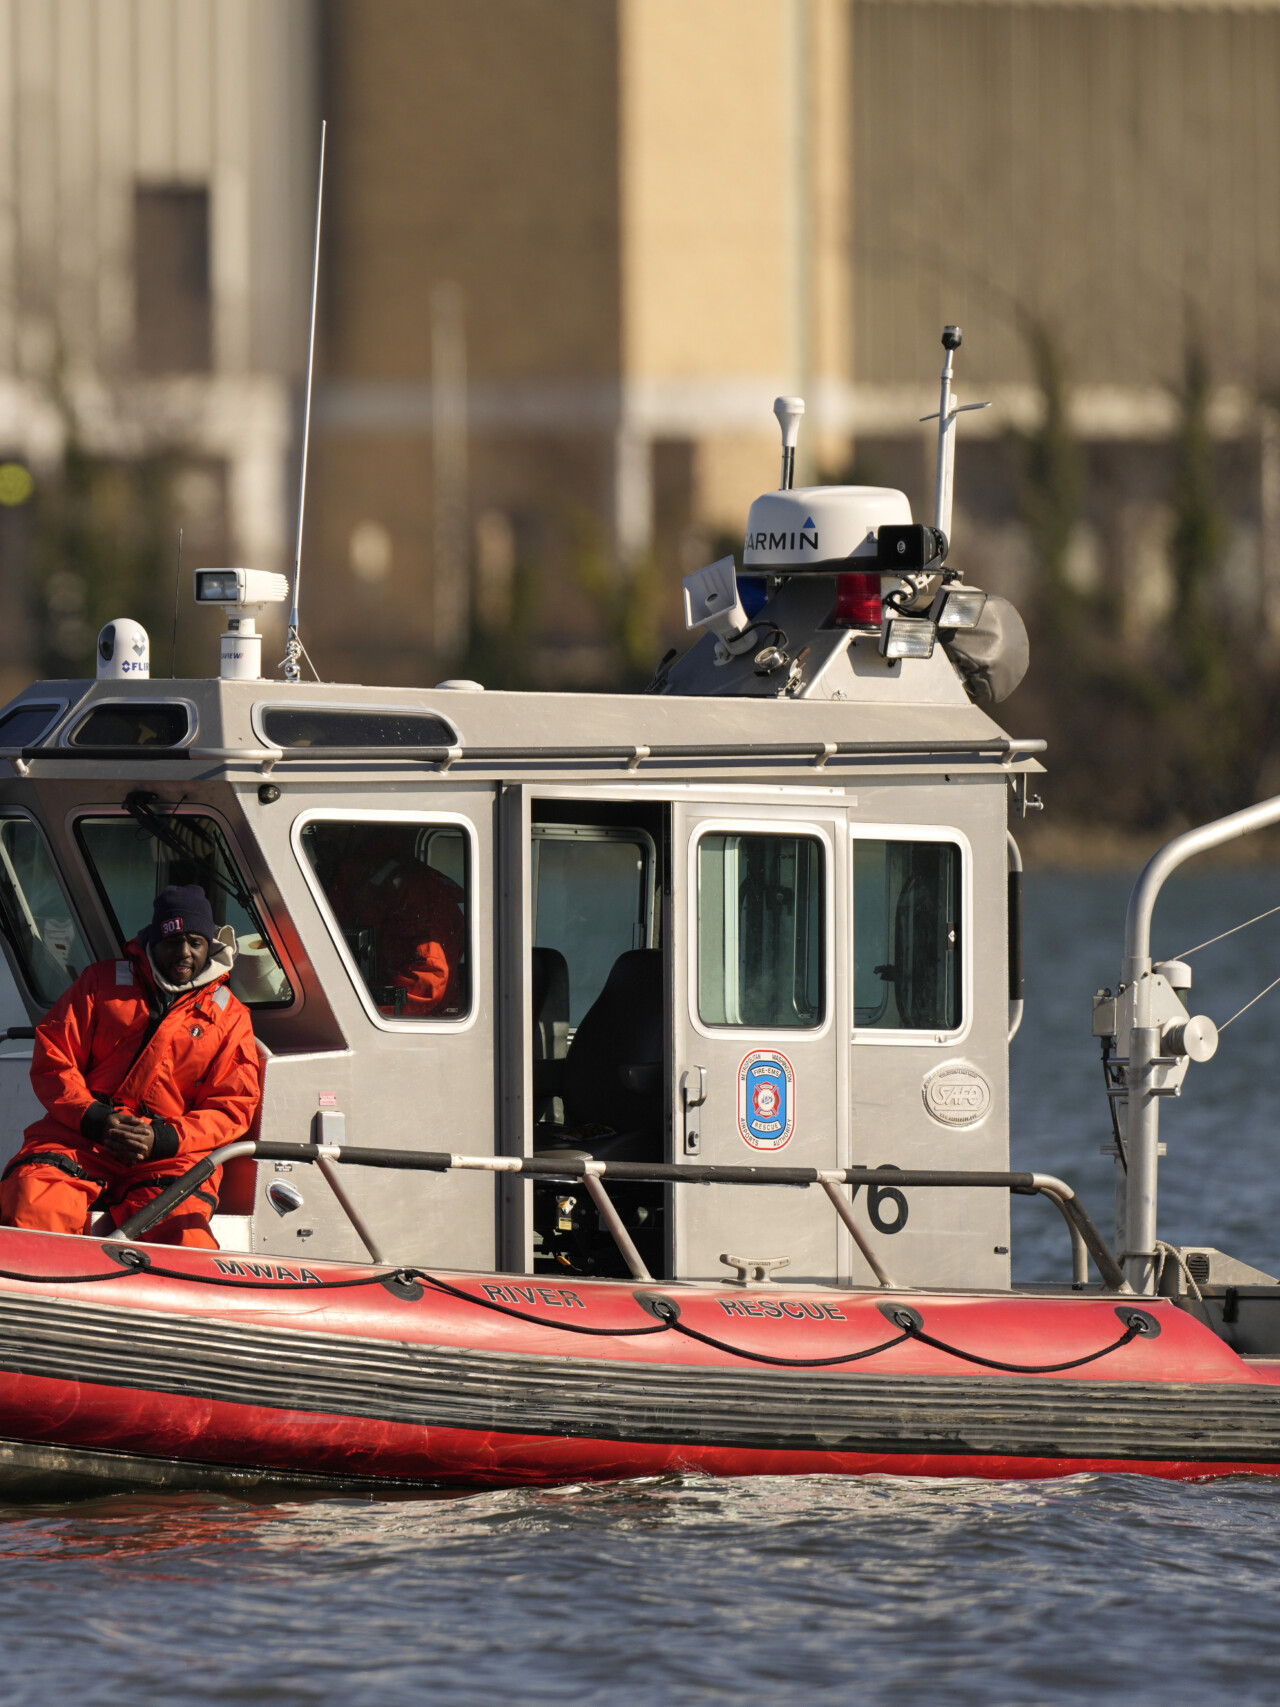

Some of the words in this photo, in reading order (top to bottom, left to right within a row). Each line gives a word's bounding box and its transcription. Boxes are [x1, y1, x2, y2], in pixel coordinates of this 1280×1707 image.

[162, 919, 181, 934] 301
[740, 1053, 761, 1081] METROPOLITAN
[772, 1054, 792, 1083] WASHINGTON
[753, 1067, 780, 1077] FIRE-EMS
[740, 1117, 759, 1146] AIRPORTS
[773, 1118, 792, 1147] AUTHORITY
[754, 1122, 779, 1131] RESCUE
[212, 1258, 324, 1285] MWAA
[480, 1284, 586, 1309] RIVER
[715, 1298, 848, 1321] RESCUE
